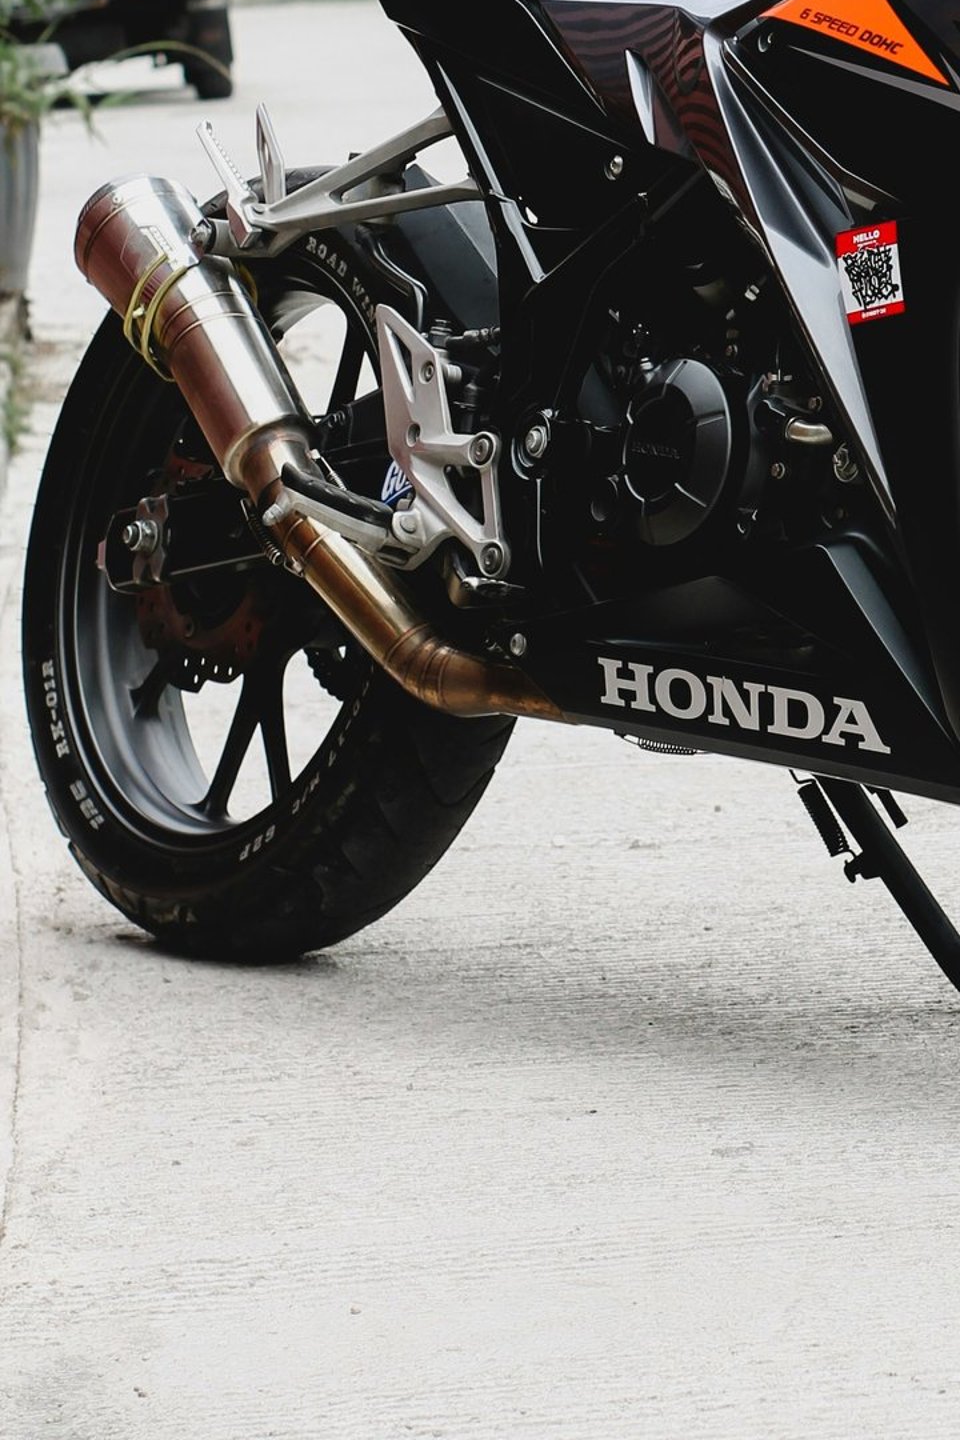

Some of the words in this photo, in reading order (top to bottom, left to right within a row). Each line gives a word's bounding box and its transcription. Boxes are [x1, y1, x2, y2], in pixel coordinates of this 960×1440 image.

[800, 8, 812, 20] 6
[812, 13, 858, 37] SPEED
[860, 29, 903, 55] DOHC
[305, 236, 348, 278] ROAD
[597, 656, 892, 755] HONDA
